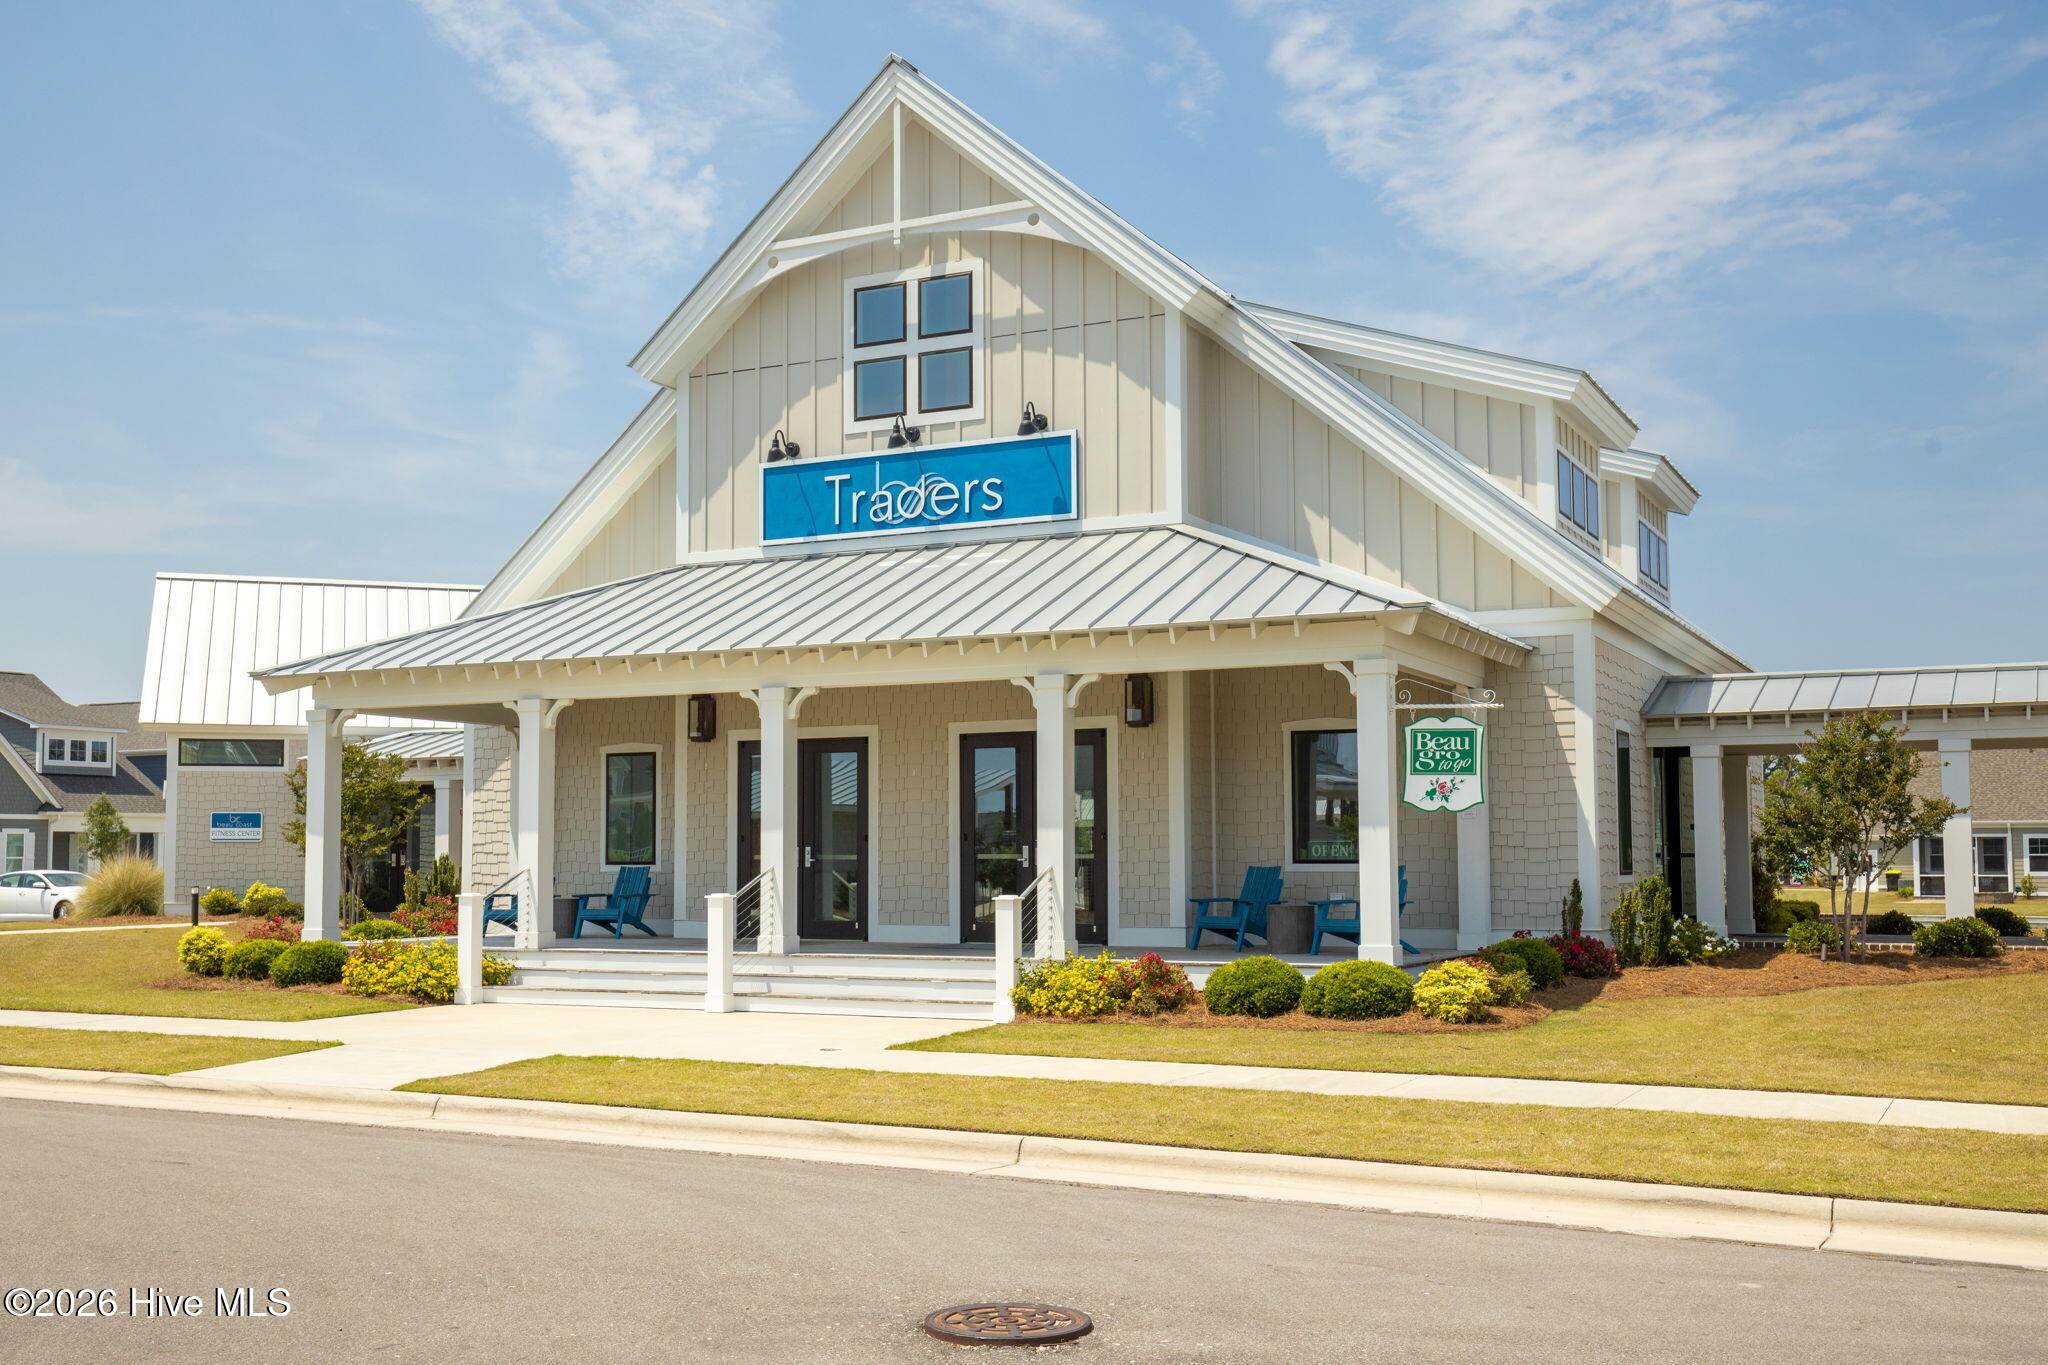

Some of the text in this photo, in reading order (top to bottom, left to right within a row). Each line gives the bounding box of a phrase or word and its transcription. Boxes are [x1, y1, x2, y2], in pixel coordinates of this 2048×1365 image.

[823, 474, 1003, 525] Traders
[1415, 732, 1470, 750] Beau
[1415, 749, 1461, 770] gro
[1438, 758, 1472, 773] to go
[1311, 844, 1349, 857] OPEN
